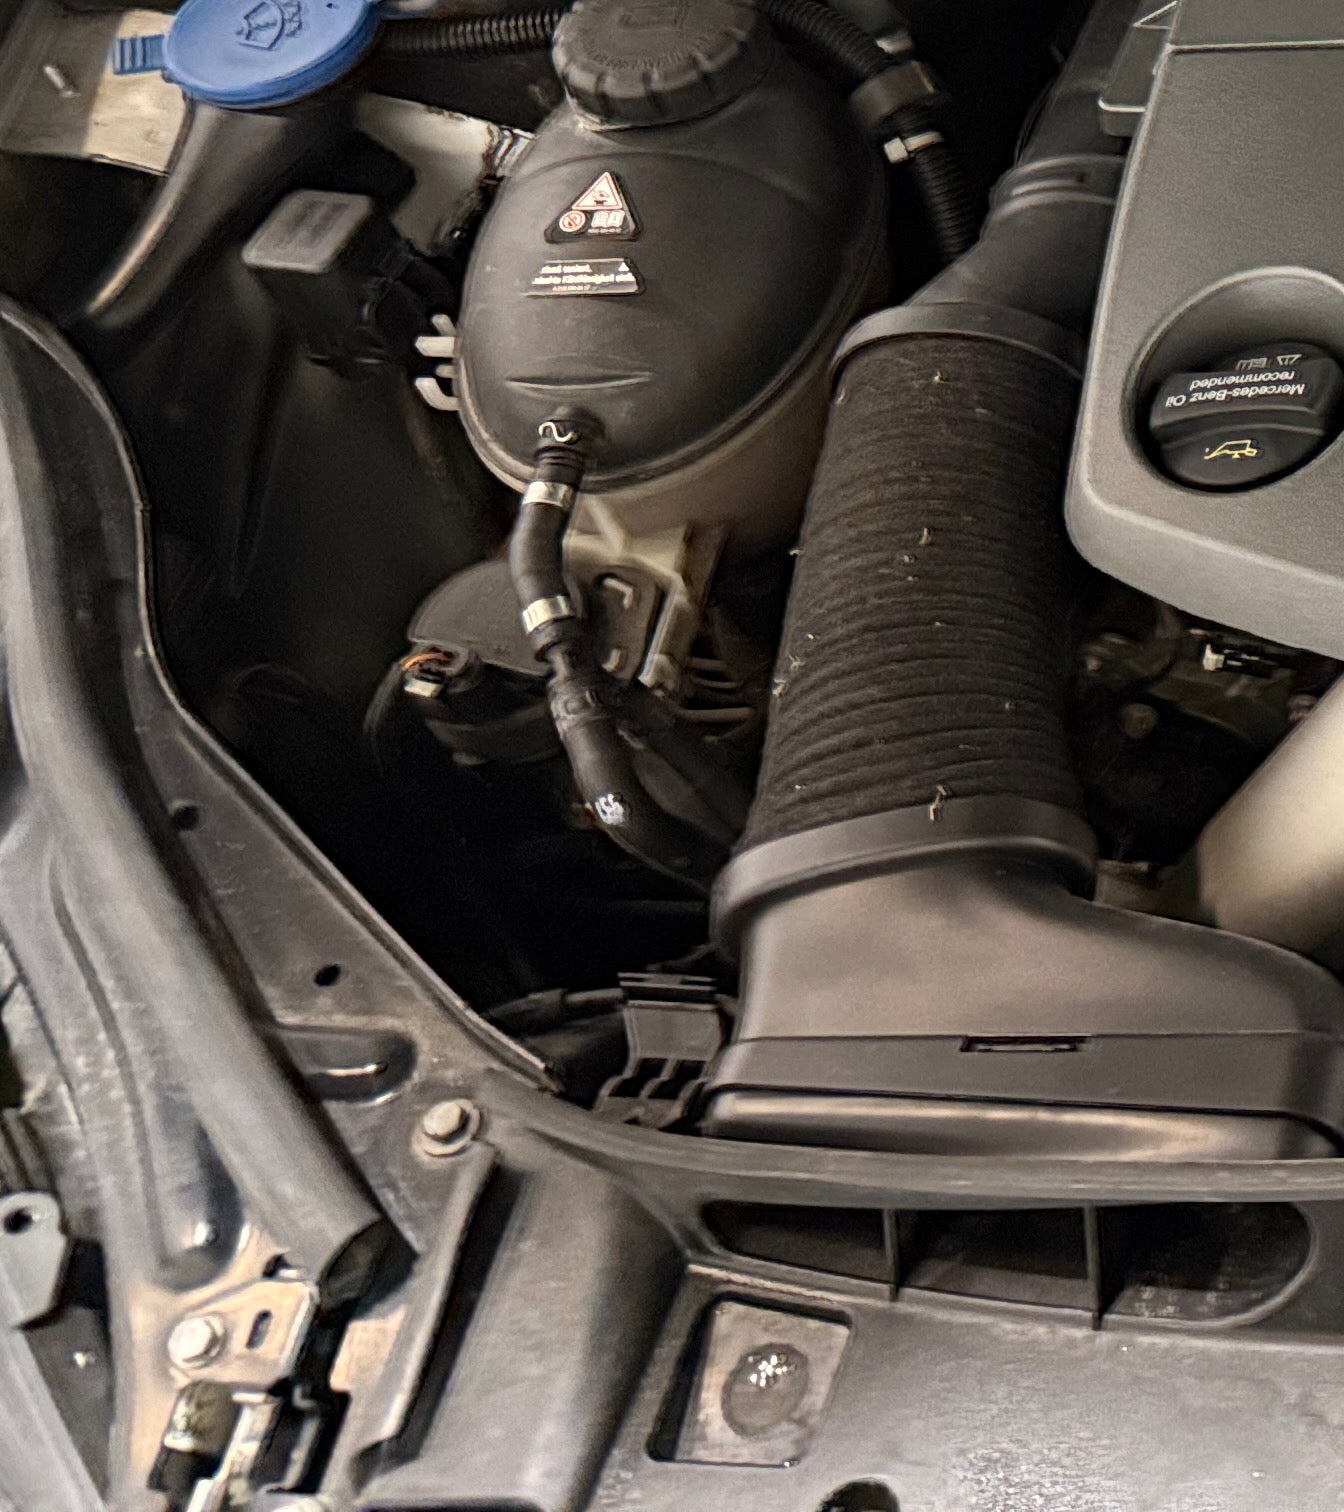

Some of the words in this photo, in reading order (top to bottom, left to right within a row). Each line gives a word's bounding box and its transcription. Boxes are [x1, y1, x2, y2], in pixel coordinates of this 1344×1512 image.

[1189, 370, 1296, 391] recommended
[1165, 394, 1187, 408] Oil
[1189, 383, 1306, 403] Mercedes-Benz
